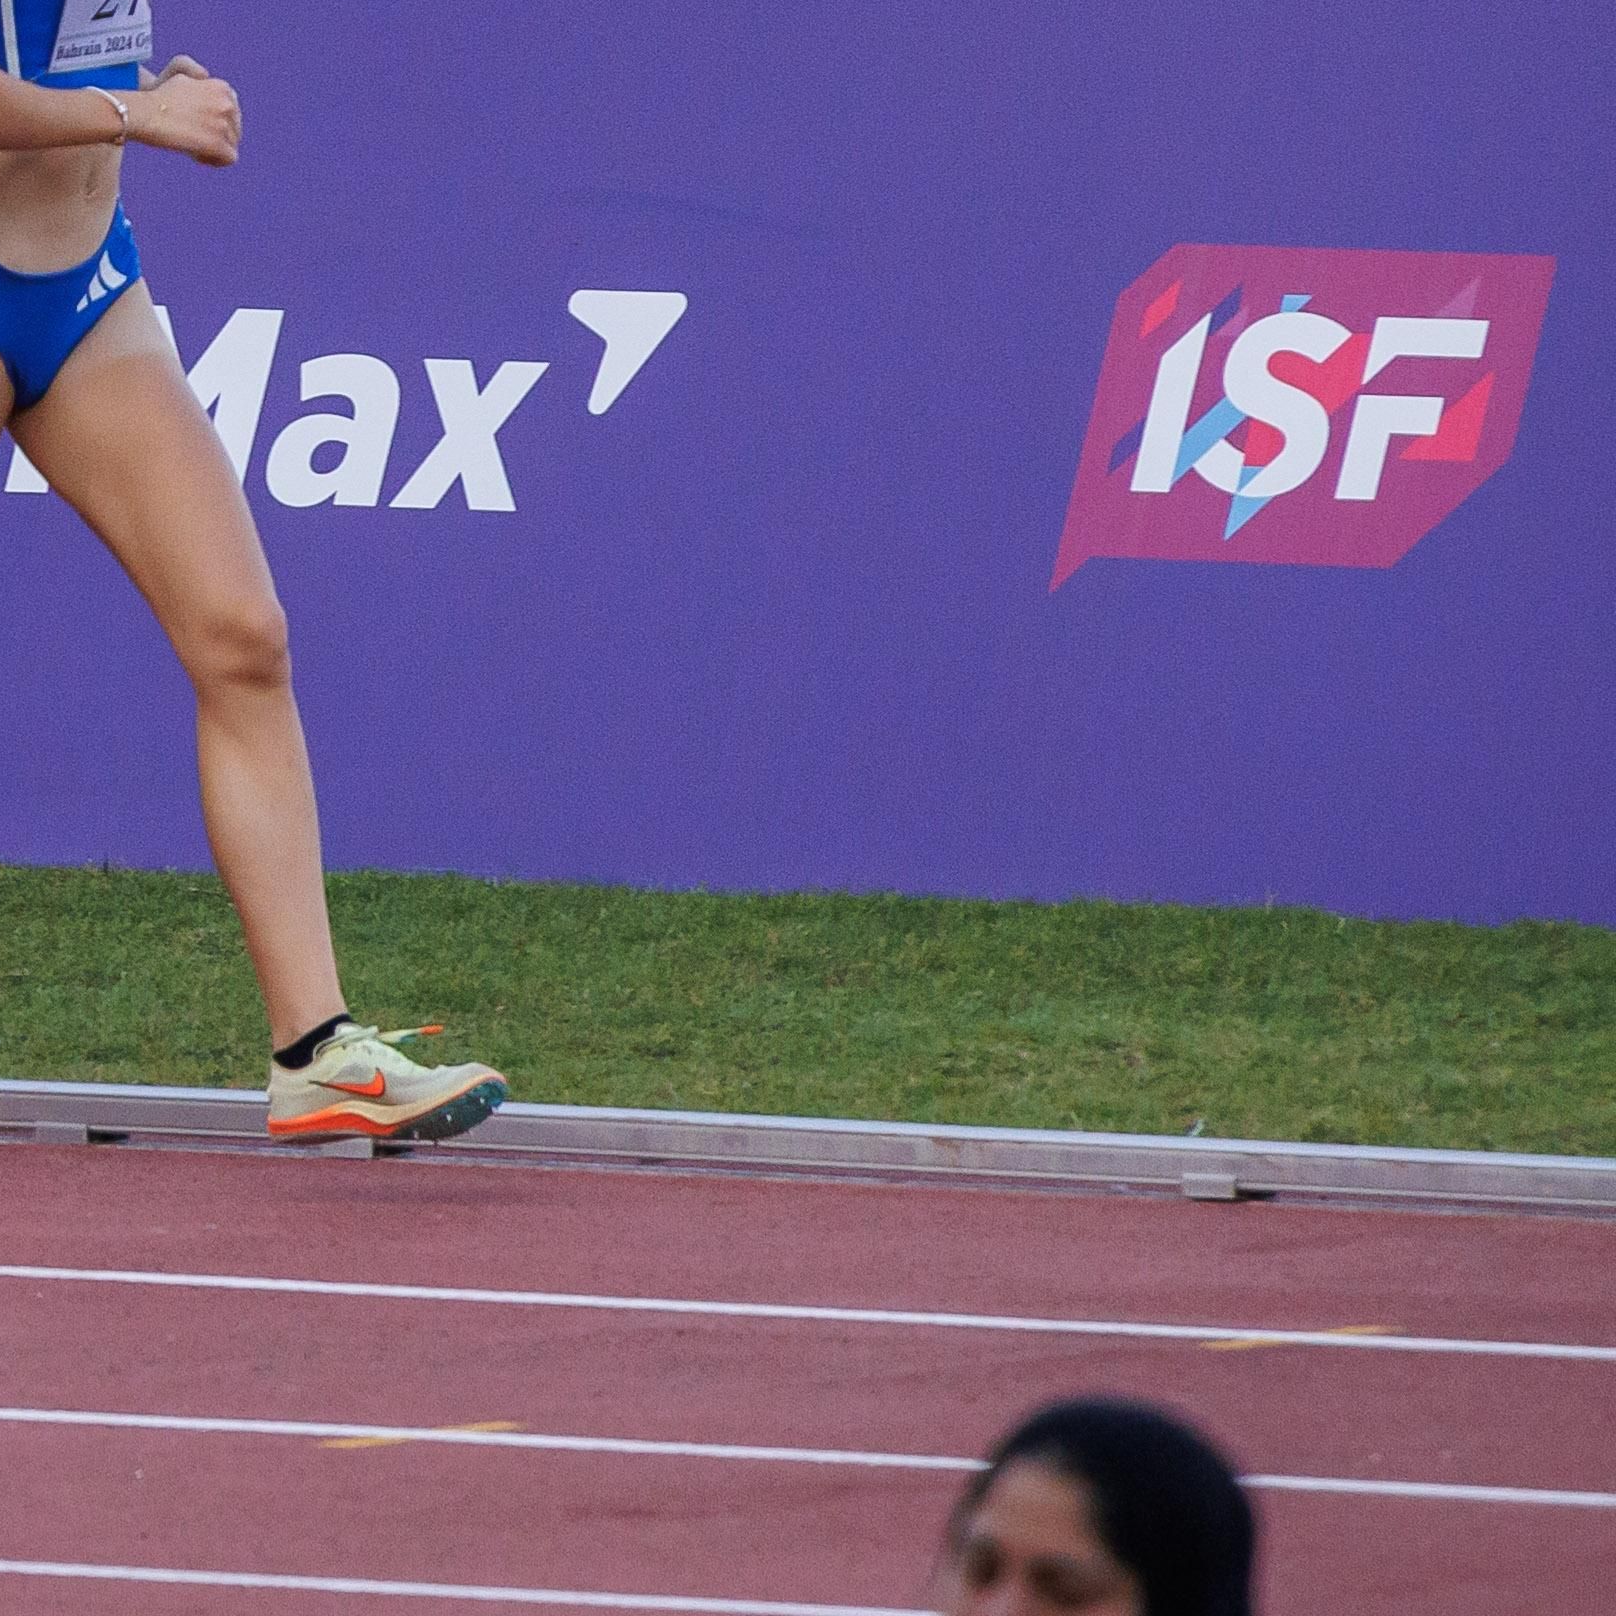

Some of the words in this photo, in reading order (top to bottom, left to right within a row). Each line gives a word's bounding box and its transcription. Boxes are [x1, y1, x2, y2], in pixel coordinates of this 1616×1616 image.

[54, 39, 103, 60] Bahrain
[105, 34, 133, 55] 2024
[1129, 311, 1491, 502] ISF
